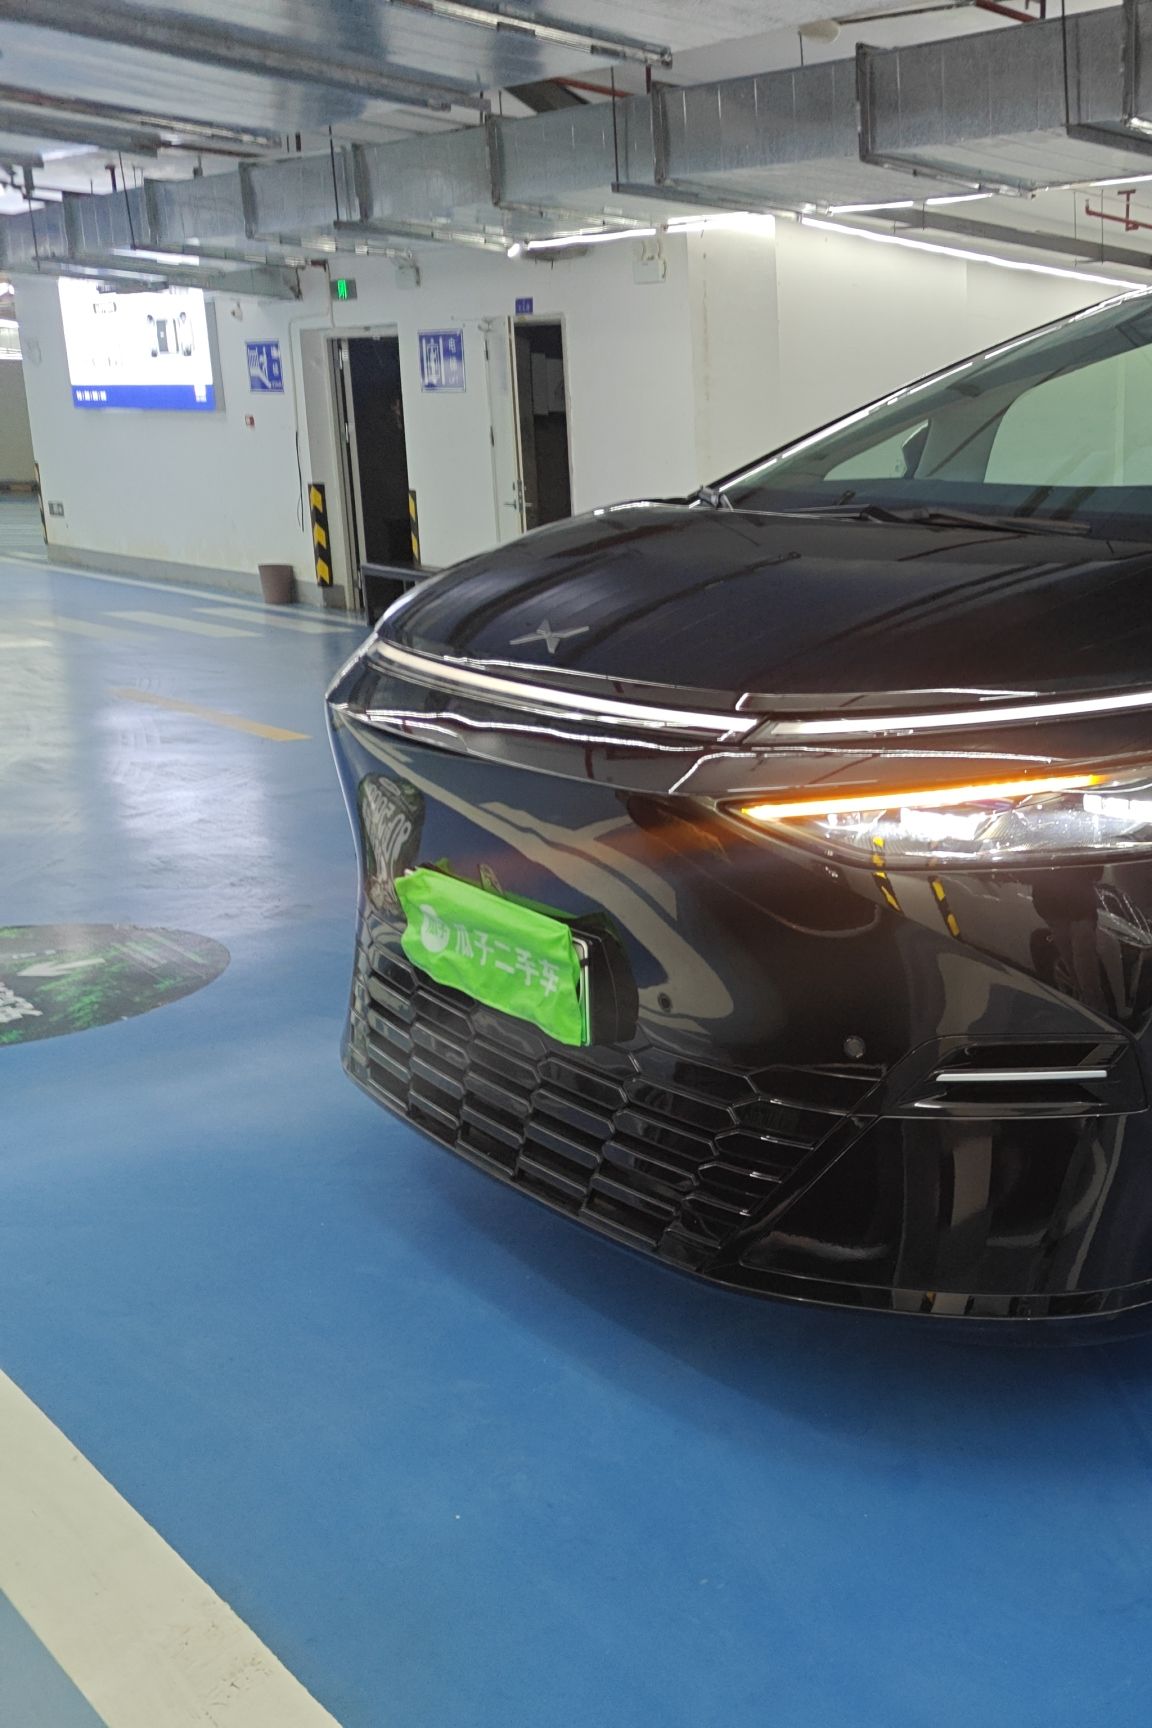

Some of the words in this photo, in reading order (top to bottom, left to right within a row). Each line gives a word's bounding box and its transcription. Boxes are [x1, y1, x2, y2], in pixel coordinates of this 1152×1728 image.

[455, 923, 560, 996] 瓜子二手车
